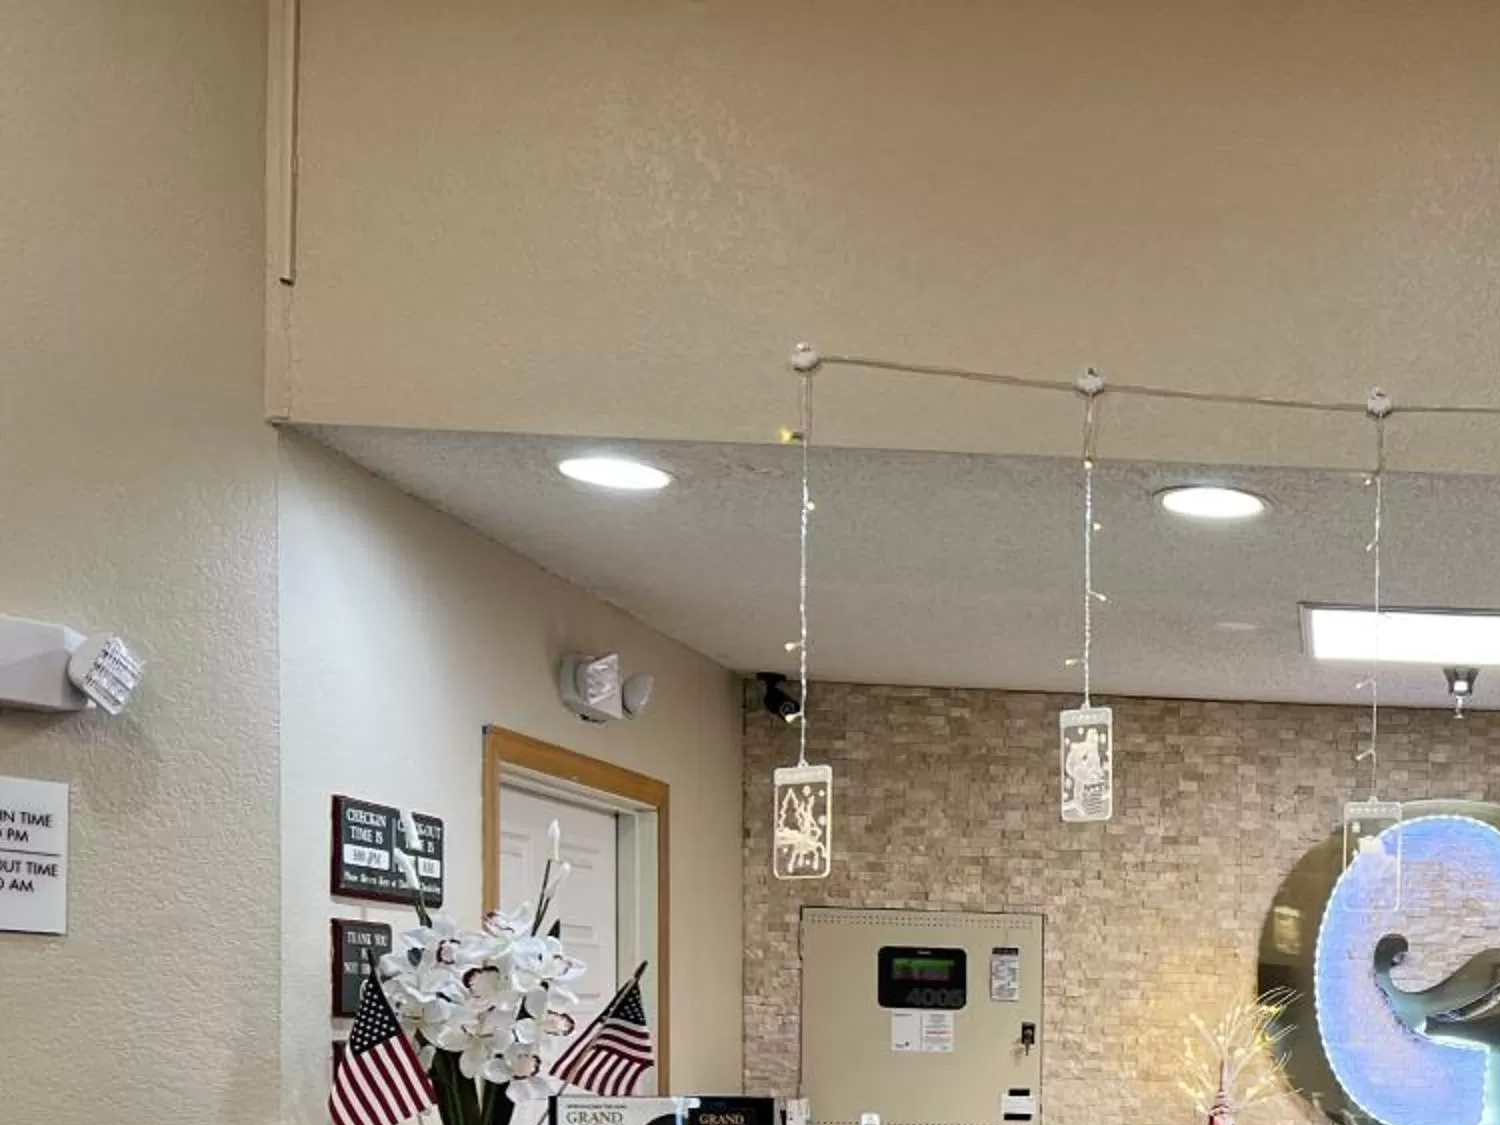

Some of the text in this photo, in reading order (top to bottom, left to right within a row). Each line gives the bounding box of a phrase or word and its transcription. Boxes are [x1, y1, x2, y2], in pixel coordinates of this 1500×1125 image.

[20, 811, 53, 828] TIME
[7, 827, 29, 841] PM
[25, 861, 58, 877] TIME
[9, 879, 34, 892] AM
[565, 1111, 625, 1124] GRAND
[699, 1112, 746, 1125] GRAND
